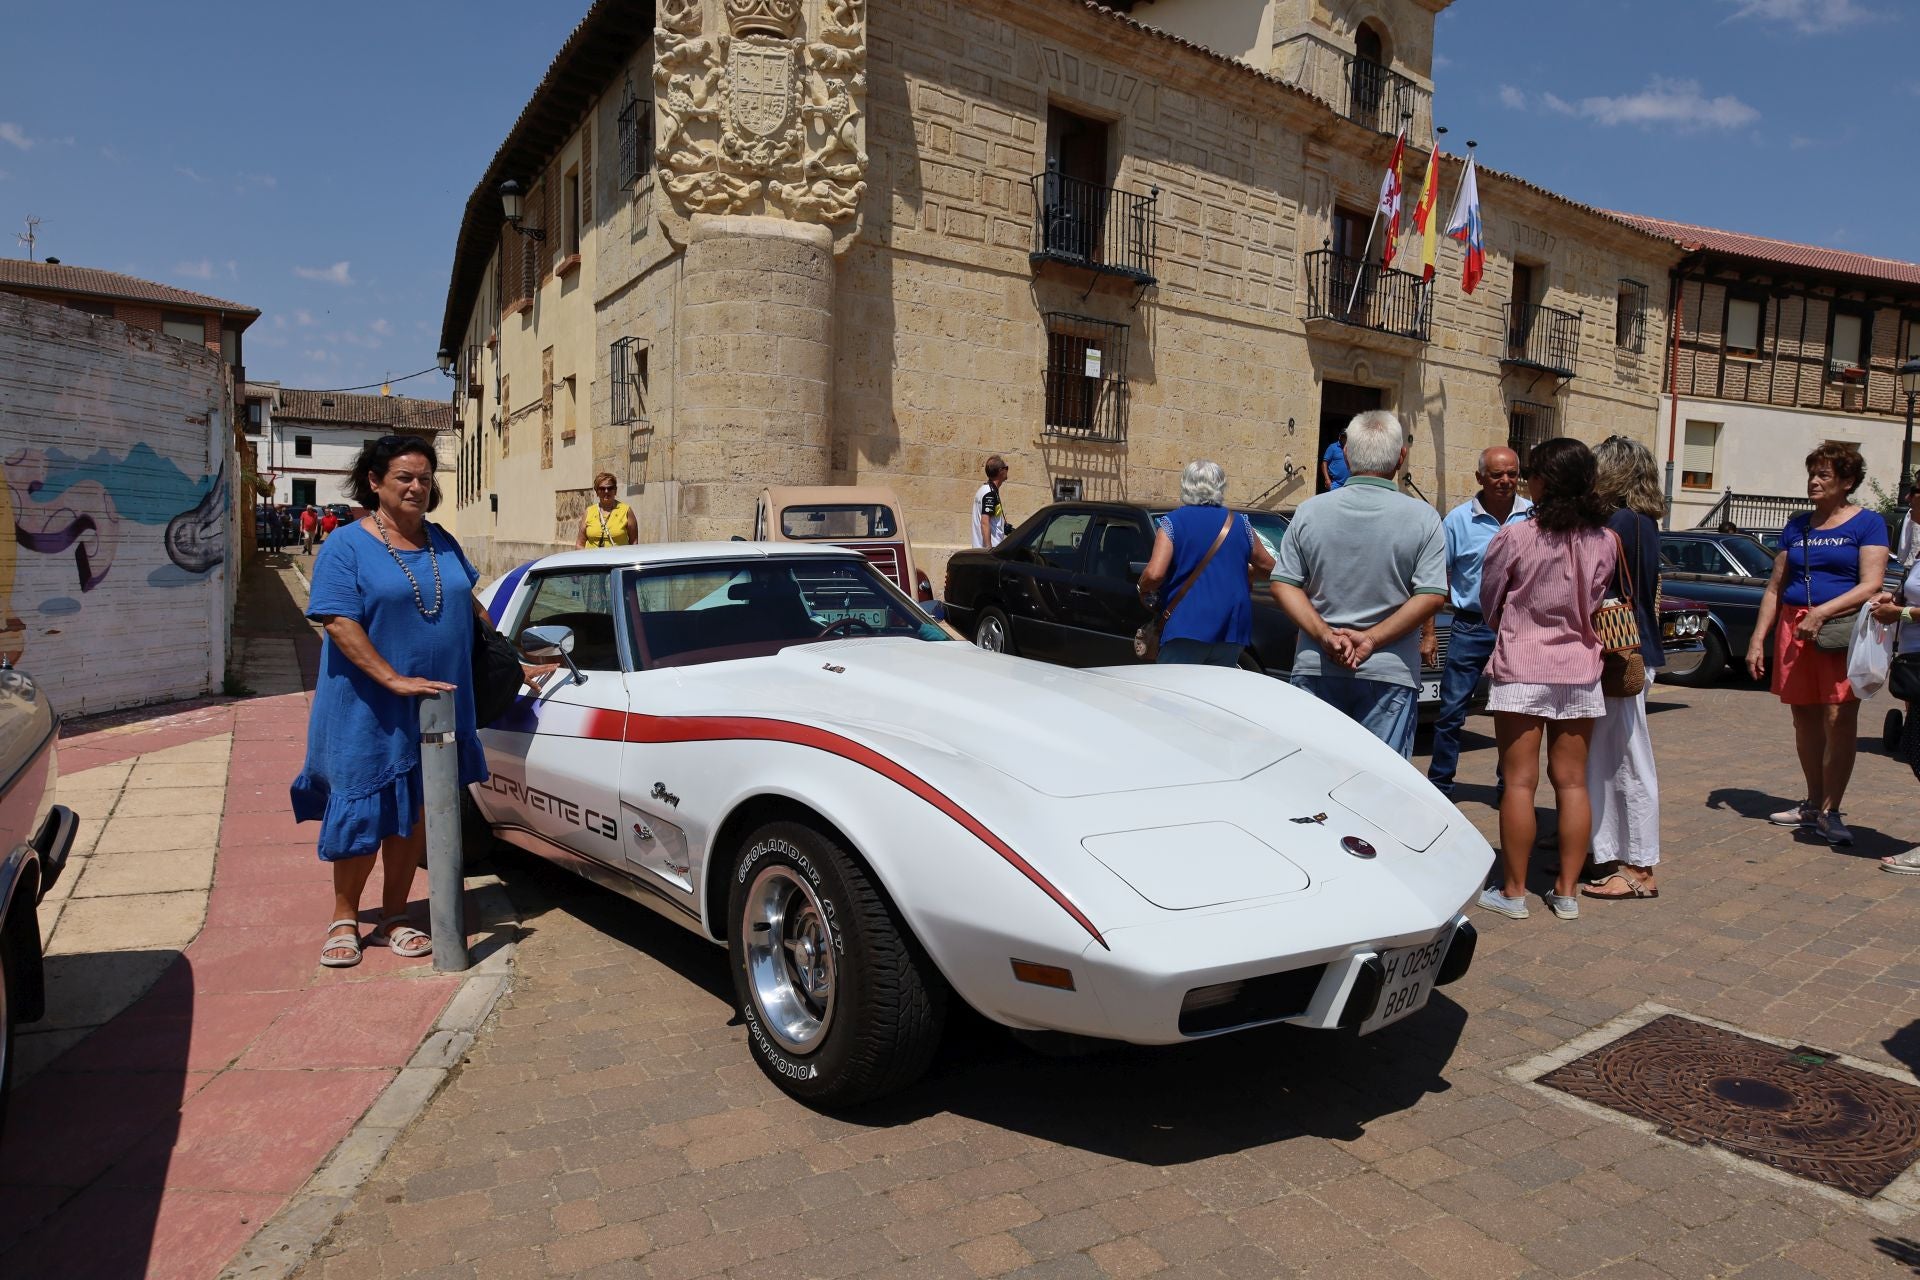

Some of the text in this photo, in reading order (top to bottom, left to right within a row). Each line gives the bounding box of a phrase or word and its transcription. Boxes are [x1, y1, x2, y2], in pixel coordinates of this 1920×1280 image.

[585, 809, 617, 841] C3
[738, 839, 844, 956] GEOLANDAR A/T
[1401, 940, 1442, 978] 0255
[1383, 982, 1420, 1019] BBD
[744, 1004, 818, 1080] YOKOHAMA
